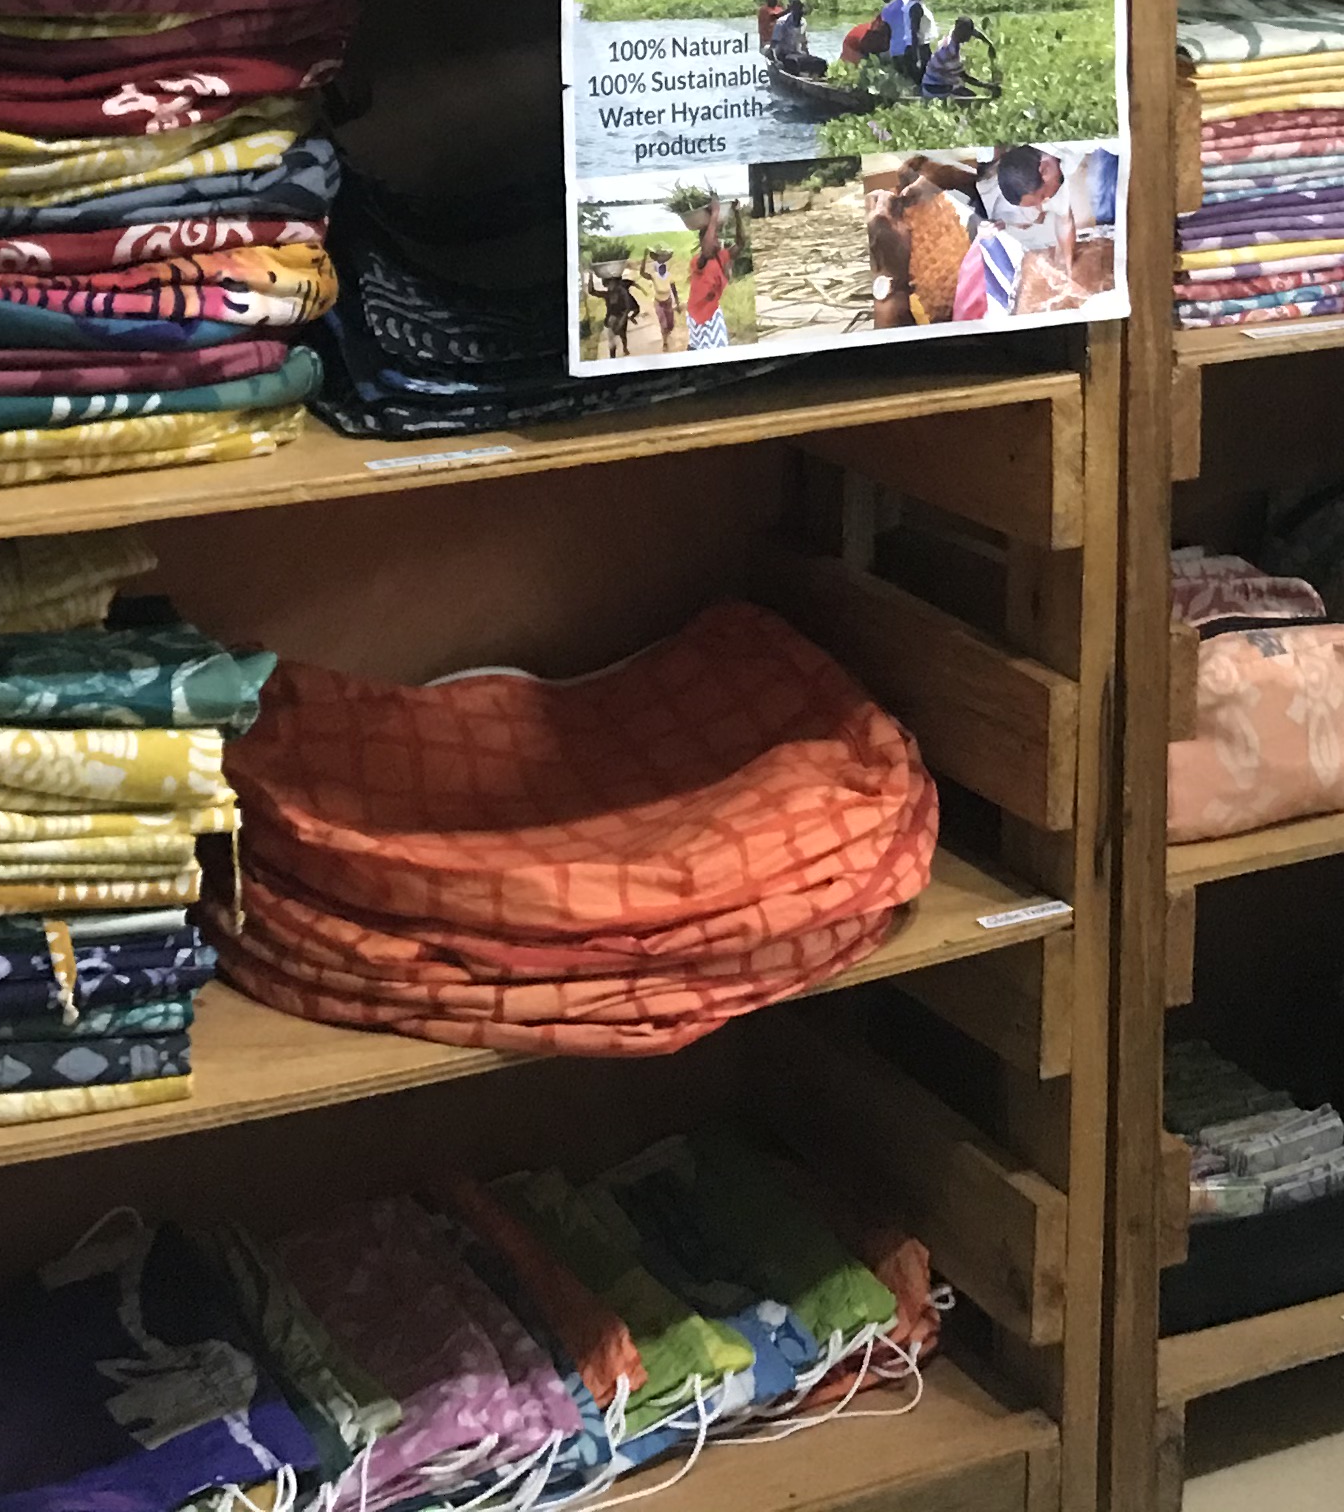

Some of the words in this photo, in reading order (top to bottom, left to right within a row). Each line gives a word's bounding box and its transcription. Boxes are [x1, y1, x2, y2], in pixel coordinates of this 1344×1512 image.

[607, 38, 666, 62] 100%
[671, 33, 750, 59] Natural
[587, 72, 647, 97] 100%
[650, 65, 771, 92] Sustainable
[599, 105, 665, 129] Water
[670, 98, 764, 130] Hyacinth
[634, 133, 727, 164] products
